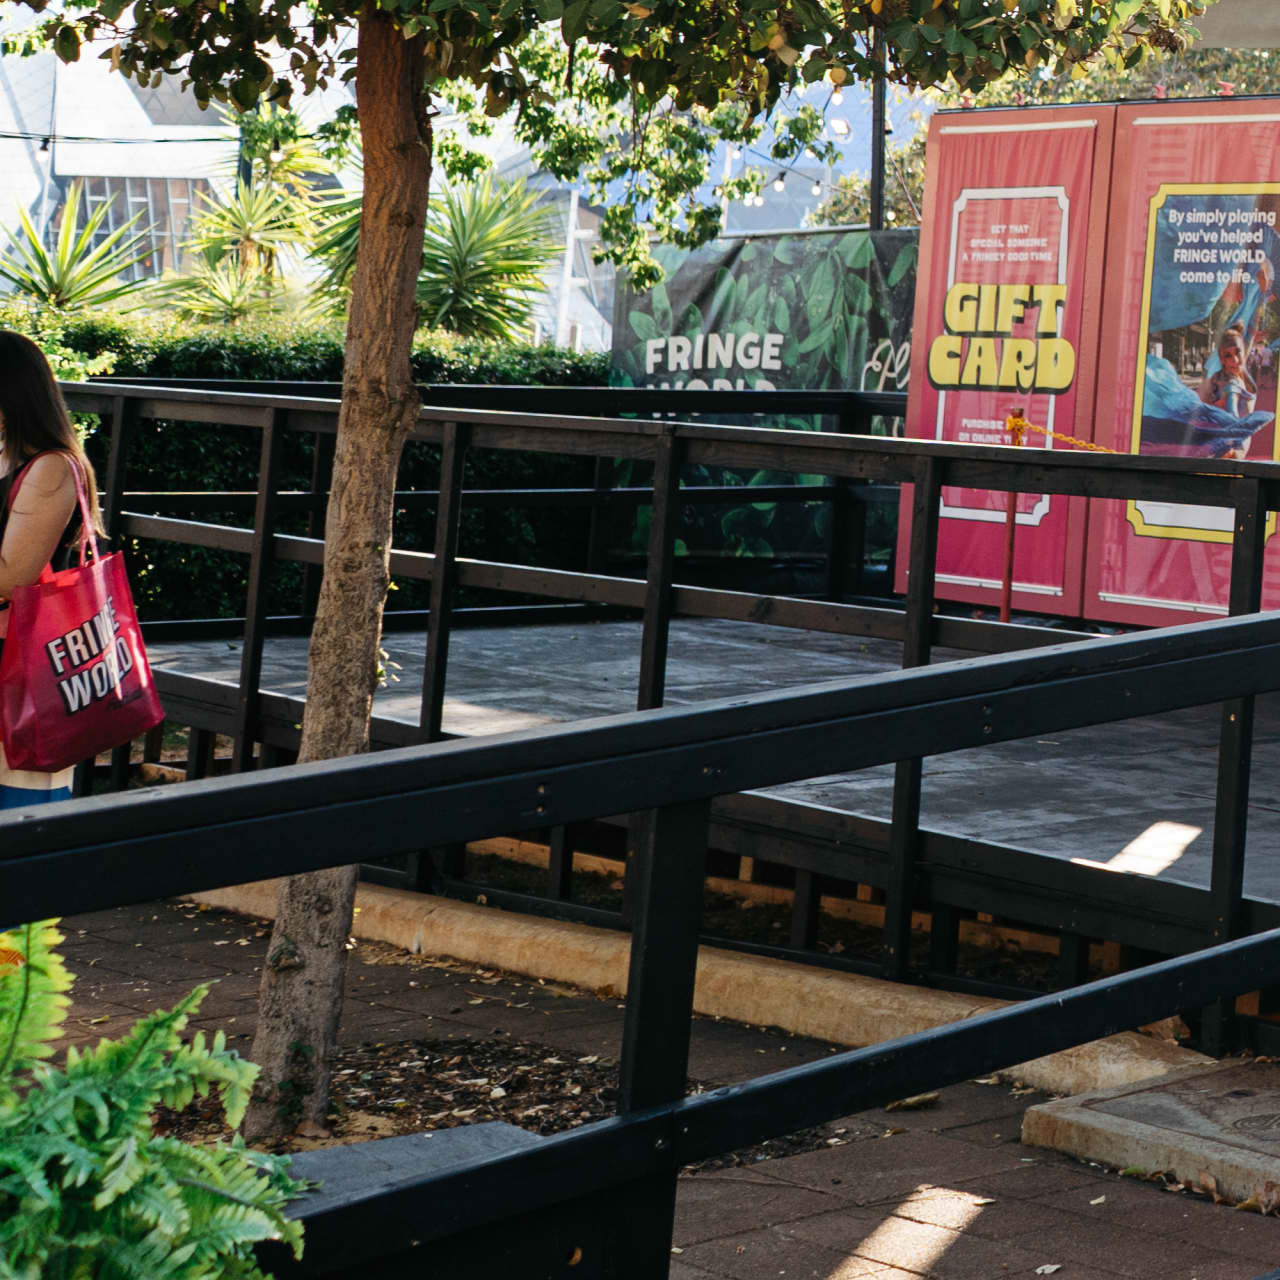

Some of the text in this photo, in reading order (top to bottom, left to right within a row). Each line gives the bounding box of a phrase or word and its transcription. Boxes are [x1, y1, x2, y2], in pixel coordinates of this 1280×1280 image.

[1168, 208, 1276, 226] By simply playing
[1177, 228, 1264, 246] you've helped
[1173, 249, 1266, 264] FRINGE WORLD
[1179, 268, 1256, 283] come to life.
[944, 282, 1068, 338] GIFT
[645, 332, 785, 375] FRINGE
[928, 335, 1076, 395] CARD
